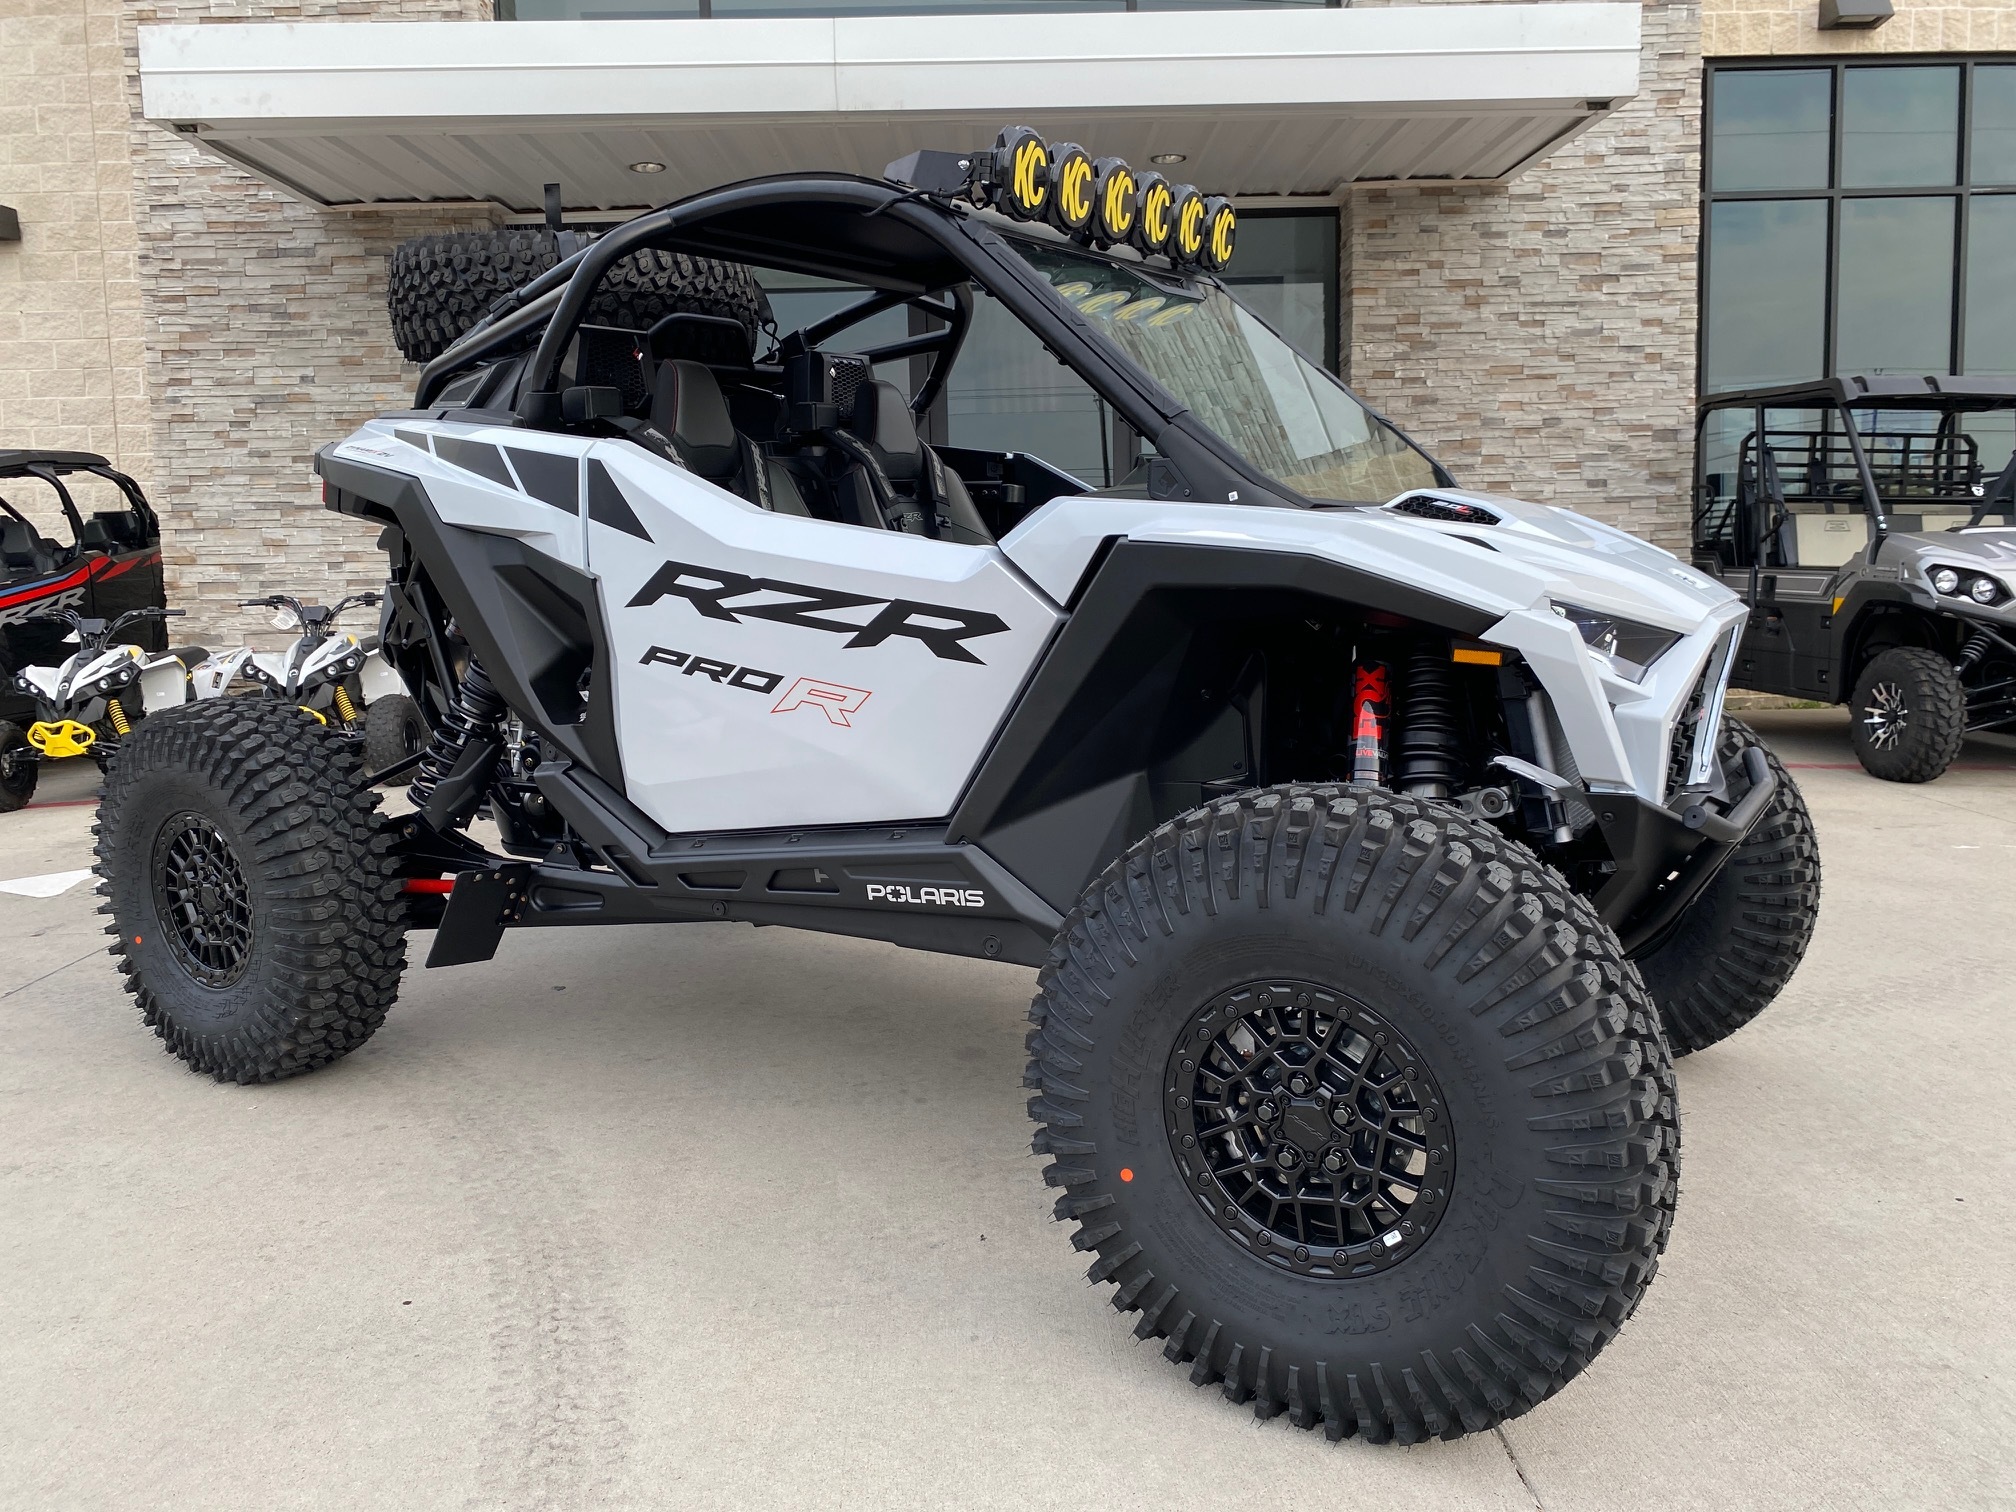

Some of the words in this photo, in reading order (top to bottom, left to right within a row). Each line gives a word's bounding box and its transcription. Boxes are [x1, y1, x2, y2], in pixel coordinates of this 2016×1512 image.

[1014, 140, 1046, 208] KC
[1061, 156, 1092, 221] KC
[1105, 171, 1133, 233] KC
[1144, 185, 1170, 243] KC
[1179, 197, 1203, 254] KC
[1212, 208, 1235, 263] KC
[0, 587, 86, 629] RZR
[624, 560, 1011, 665] RZR
[638, 645, 785, 695] PRO
[770, 677, 873, 728] R
[1353, 665, 1391, 740] FOX
[866, 884, 985, 908] POLARIS
